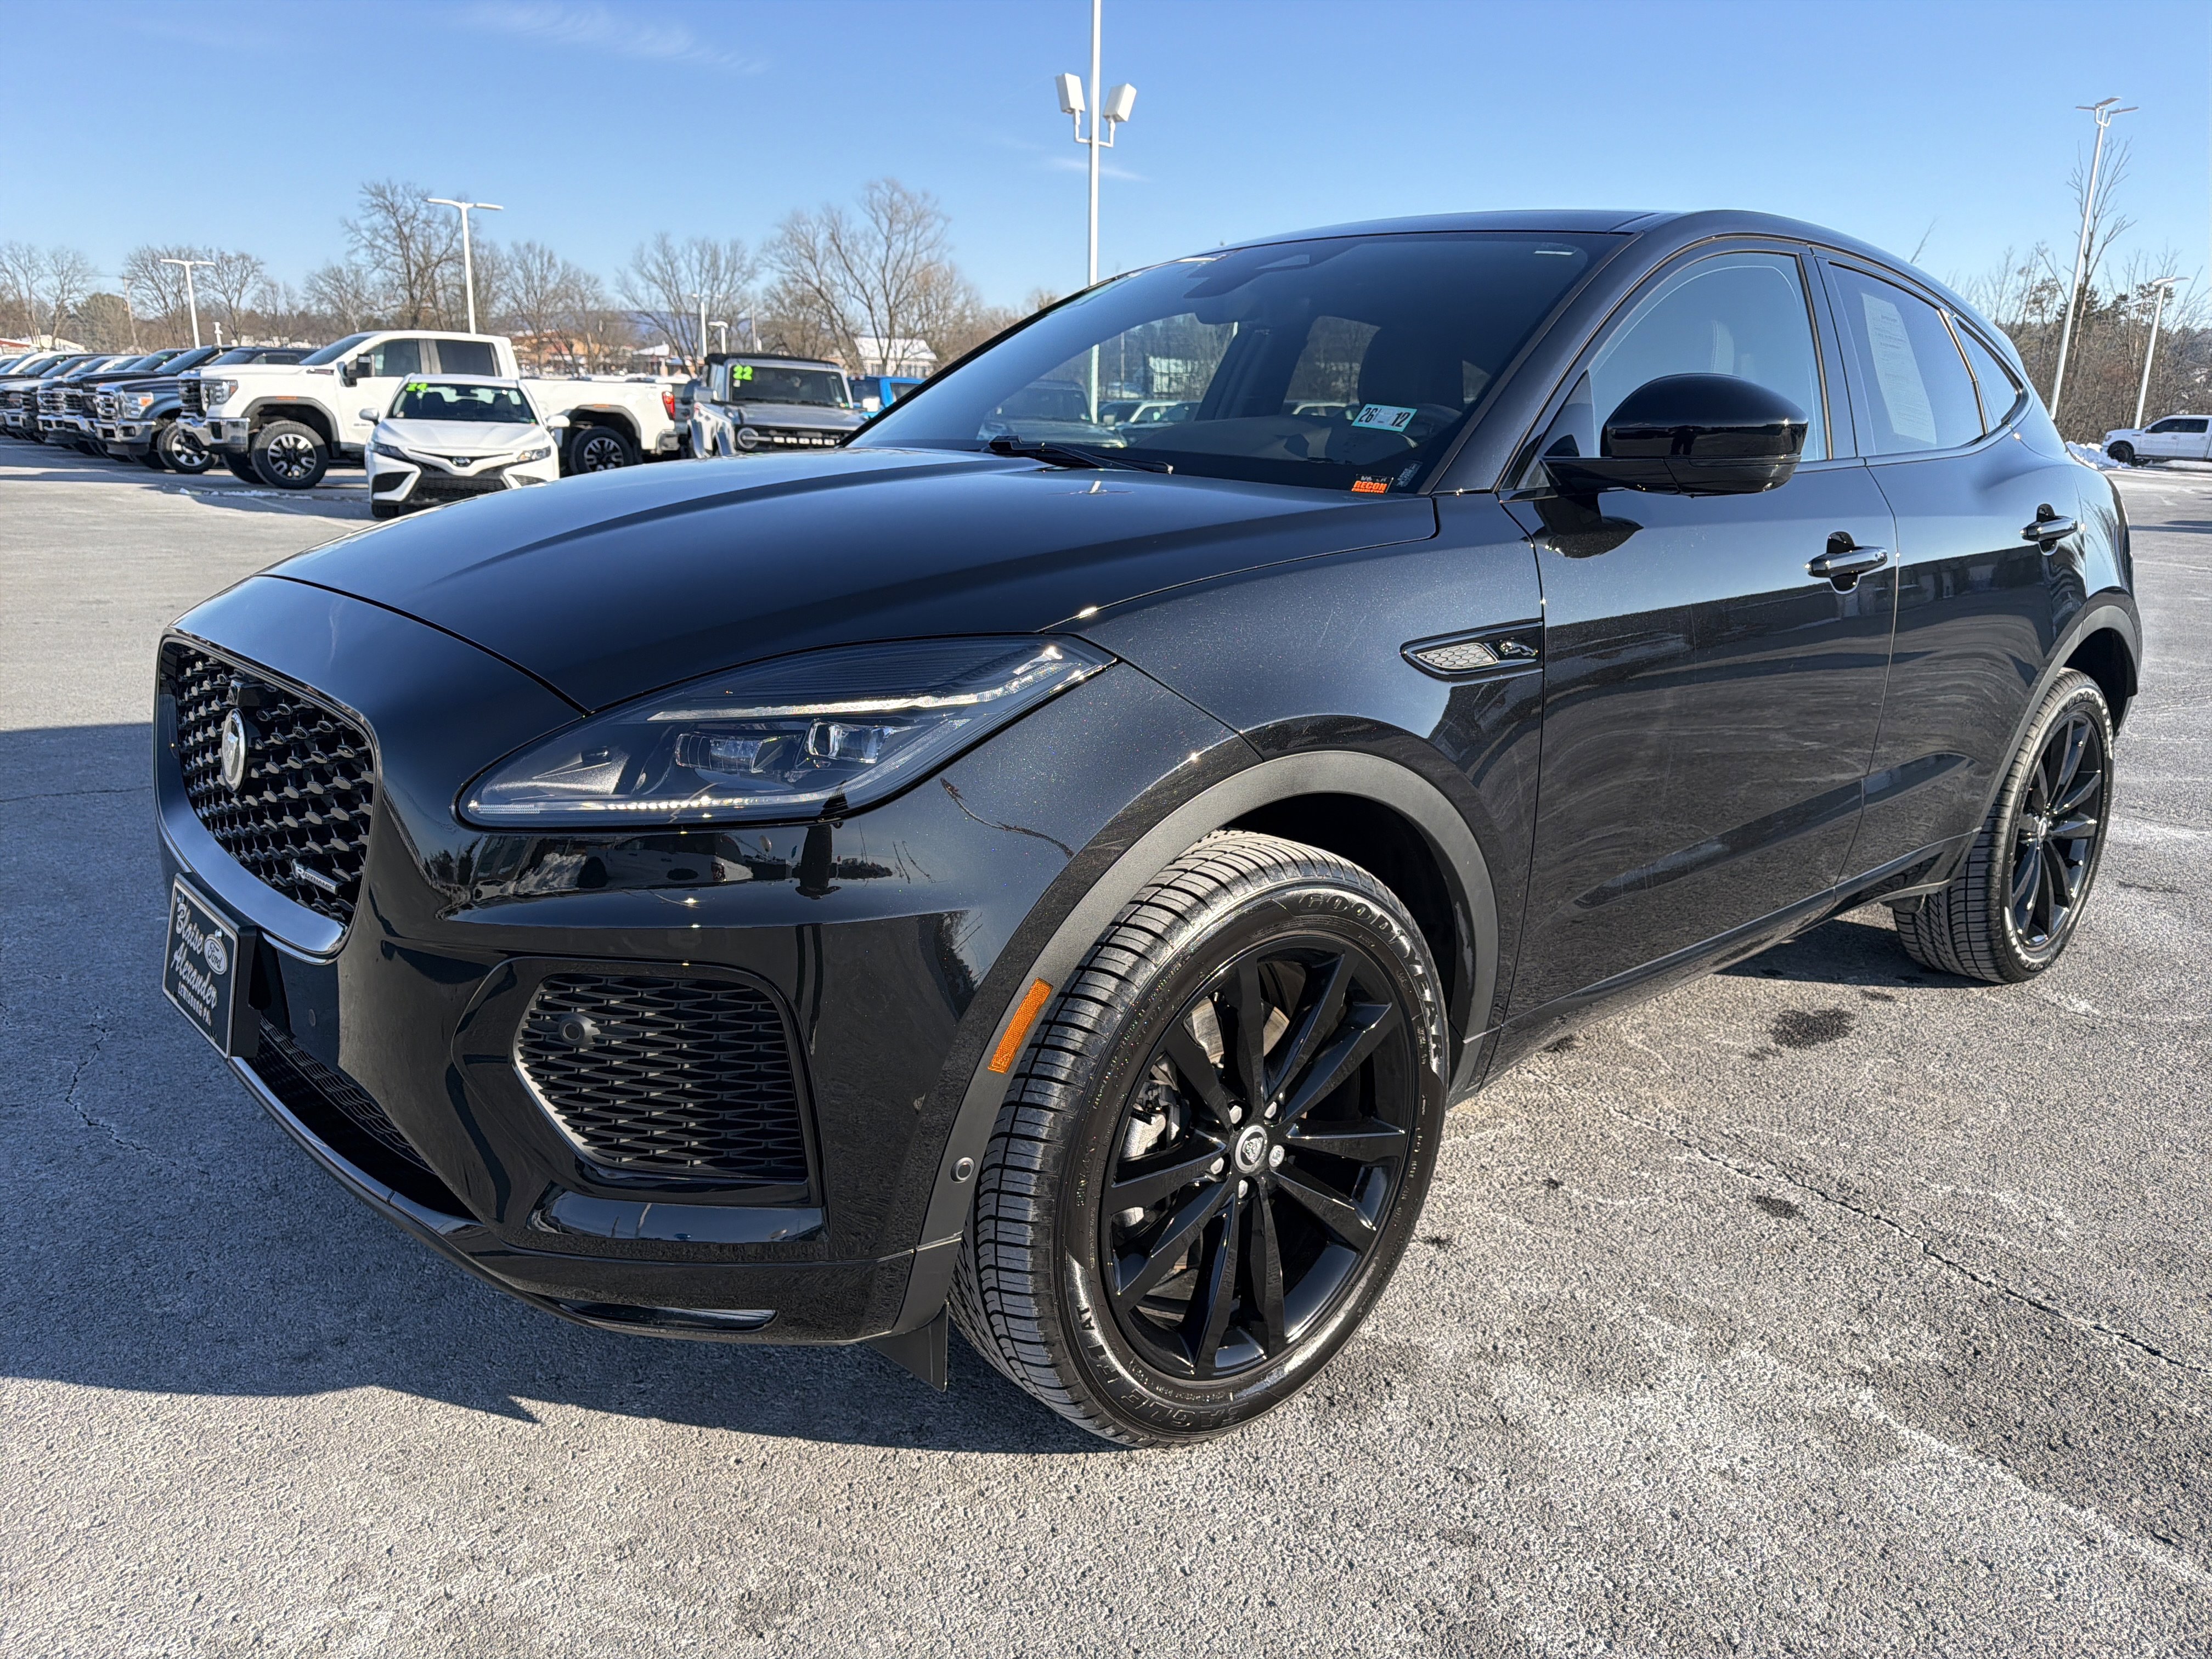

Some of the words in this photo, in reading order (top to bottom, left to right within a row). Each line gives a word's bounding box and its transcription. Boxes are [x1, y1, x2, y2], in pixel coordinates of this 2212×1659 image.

[733, 365, 753, 380] 22
[1358, 407, 1378, 423] 26
[1390, 411, 1411, 427] 12
[1353, 480, 1387, 491] RECON
[176, 902, 204, 955] Blaise
[170, 941, 218, 1011] Alexander
[1299, 893, 1443, 1058] GOODYEAR
[178, 980, 203, 1016] LEWISBURG
